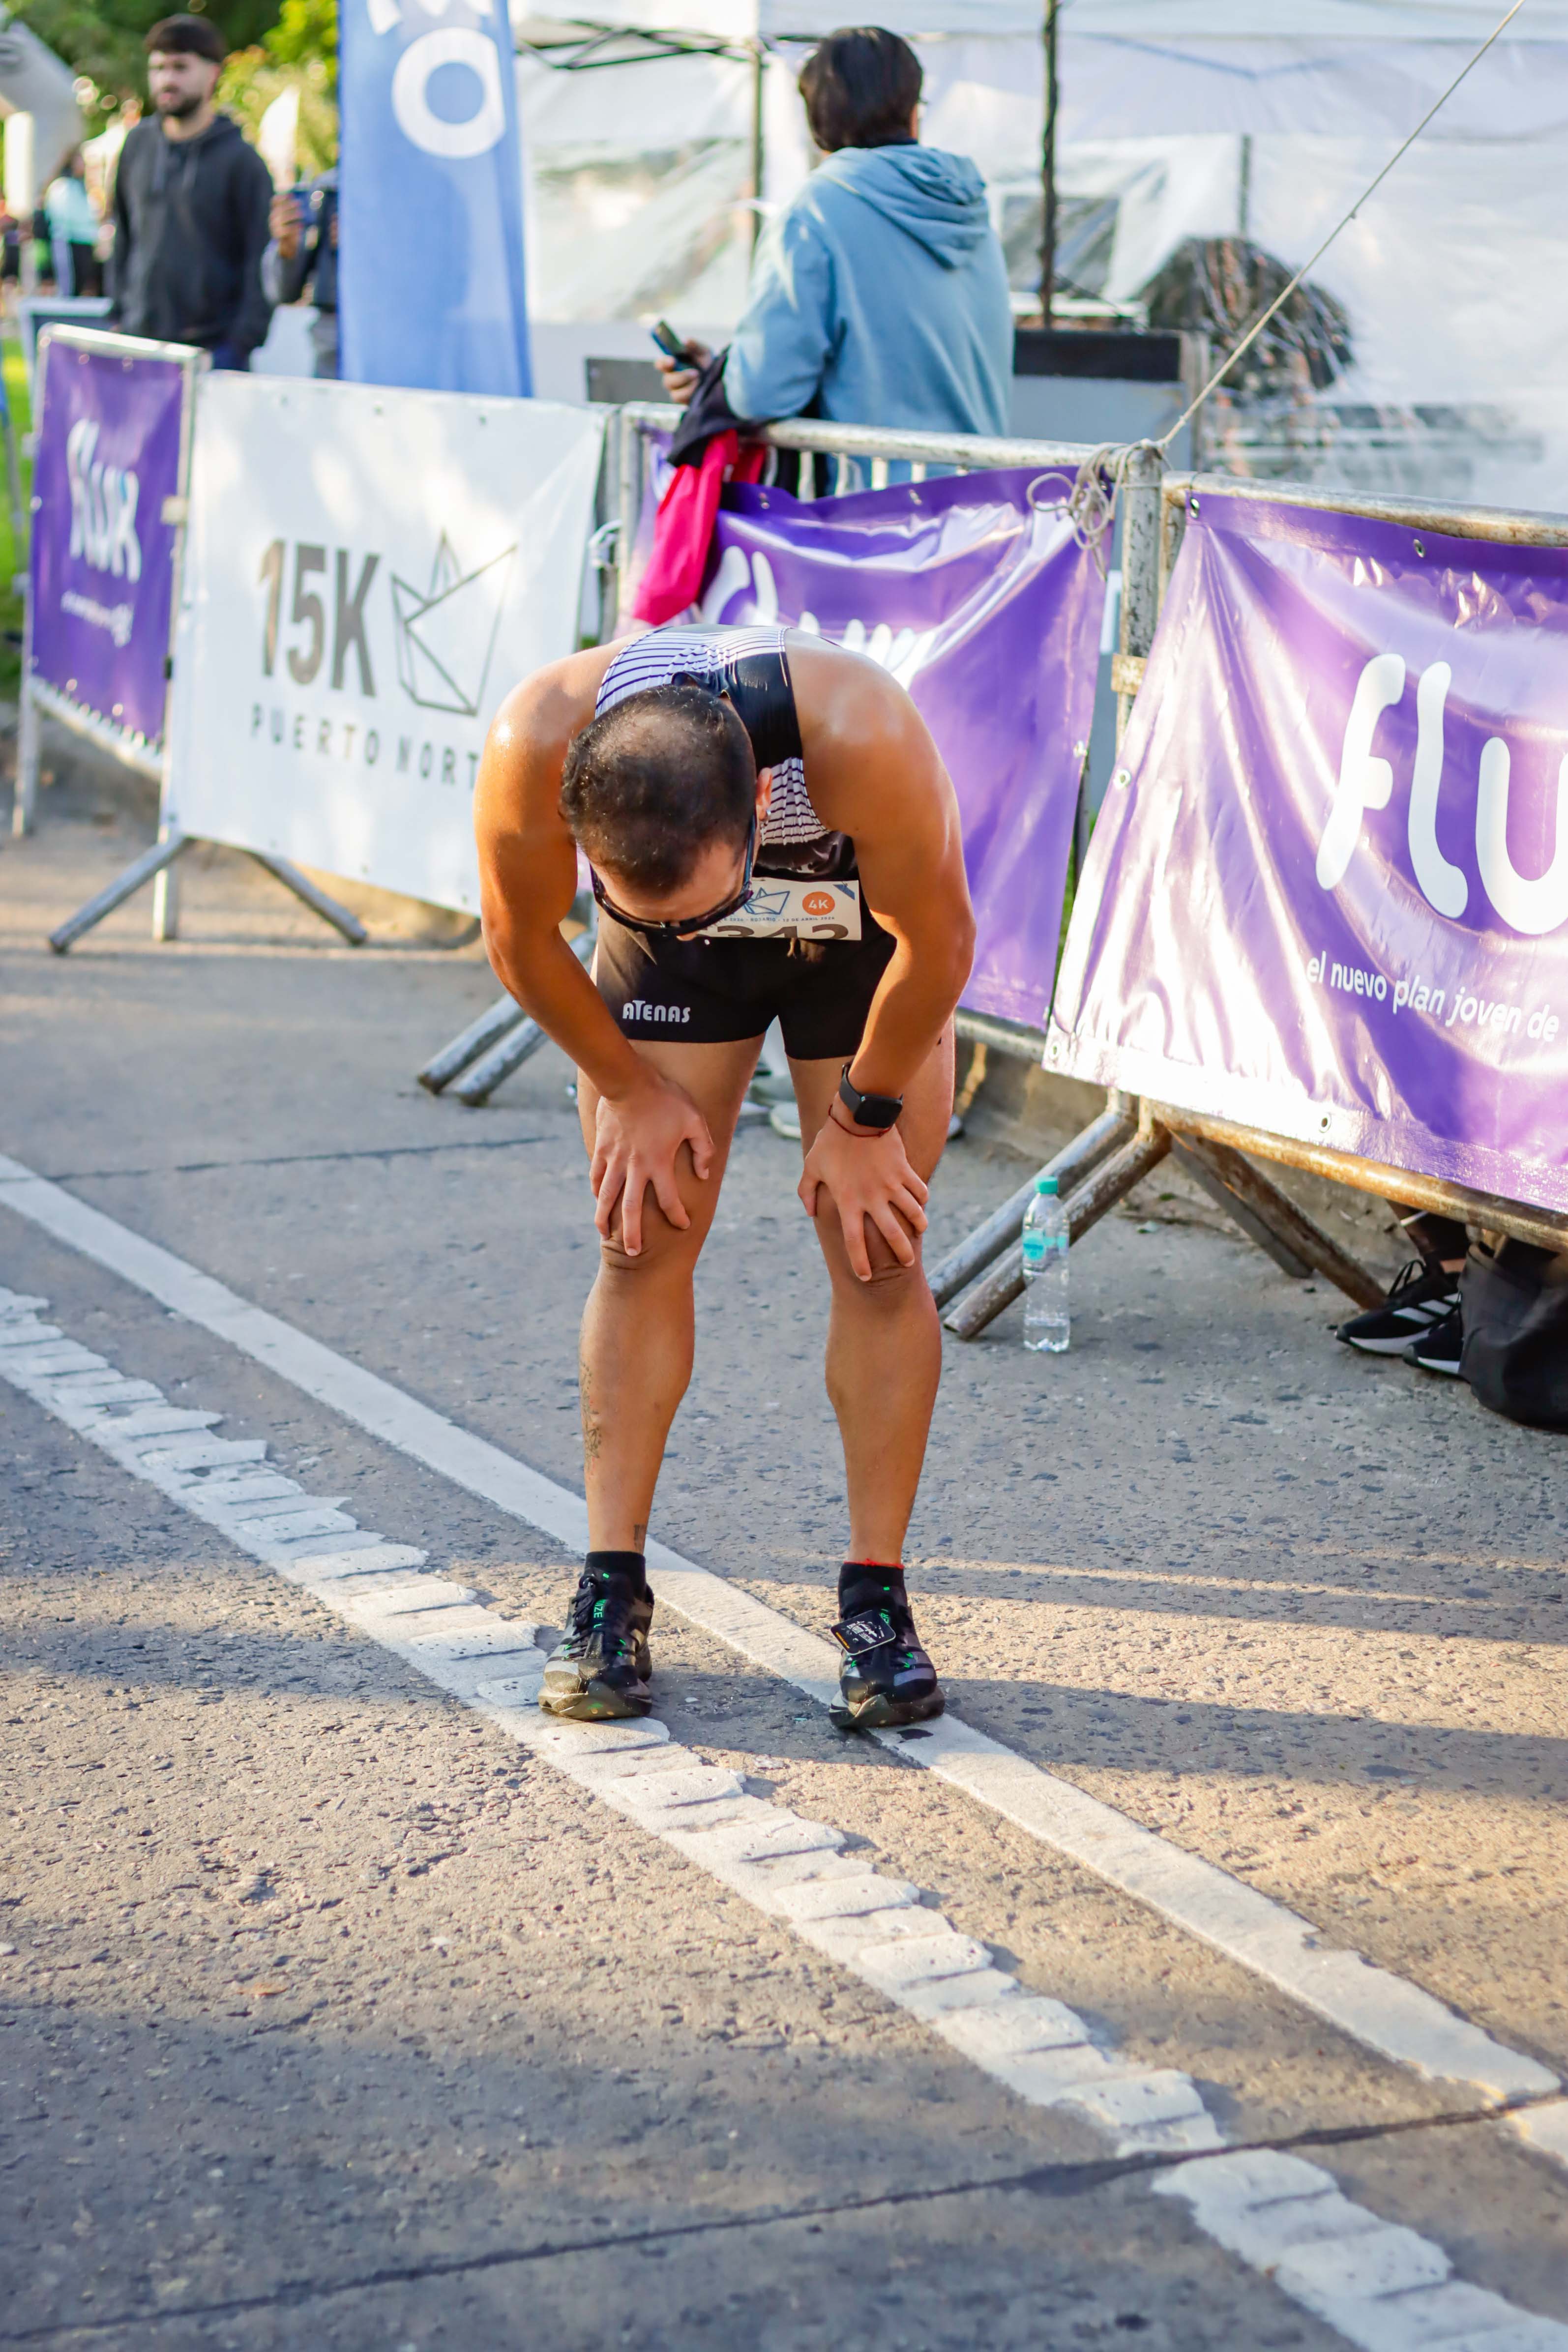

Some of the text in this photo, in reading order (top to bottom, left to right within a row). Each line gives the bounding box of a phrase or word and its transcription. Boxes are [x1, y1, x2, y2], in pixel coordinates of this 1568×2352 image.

[259, 539, 381, 697] 15K
[251, 703, 478, 789] PUERTO NORT
[808, 899, 828, 910] 4K
[622, 1000, 691, 1023] ATENAS
[1306, 950, 1559, 1042] el nuevo plan joven de
